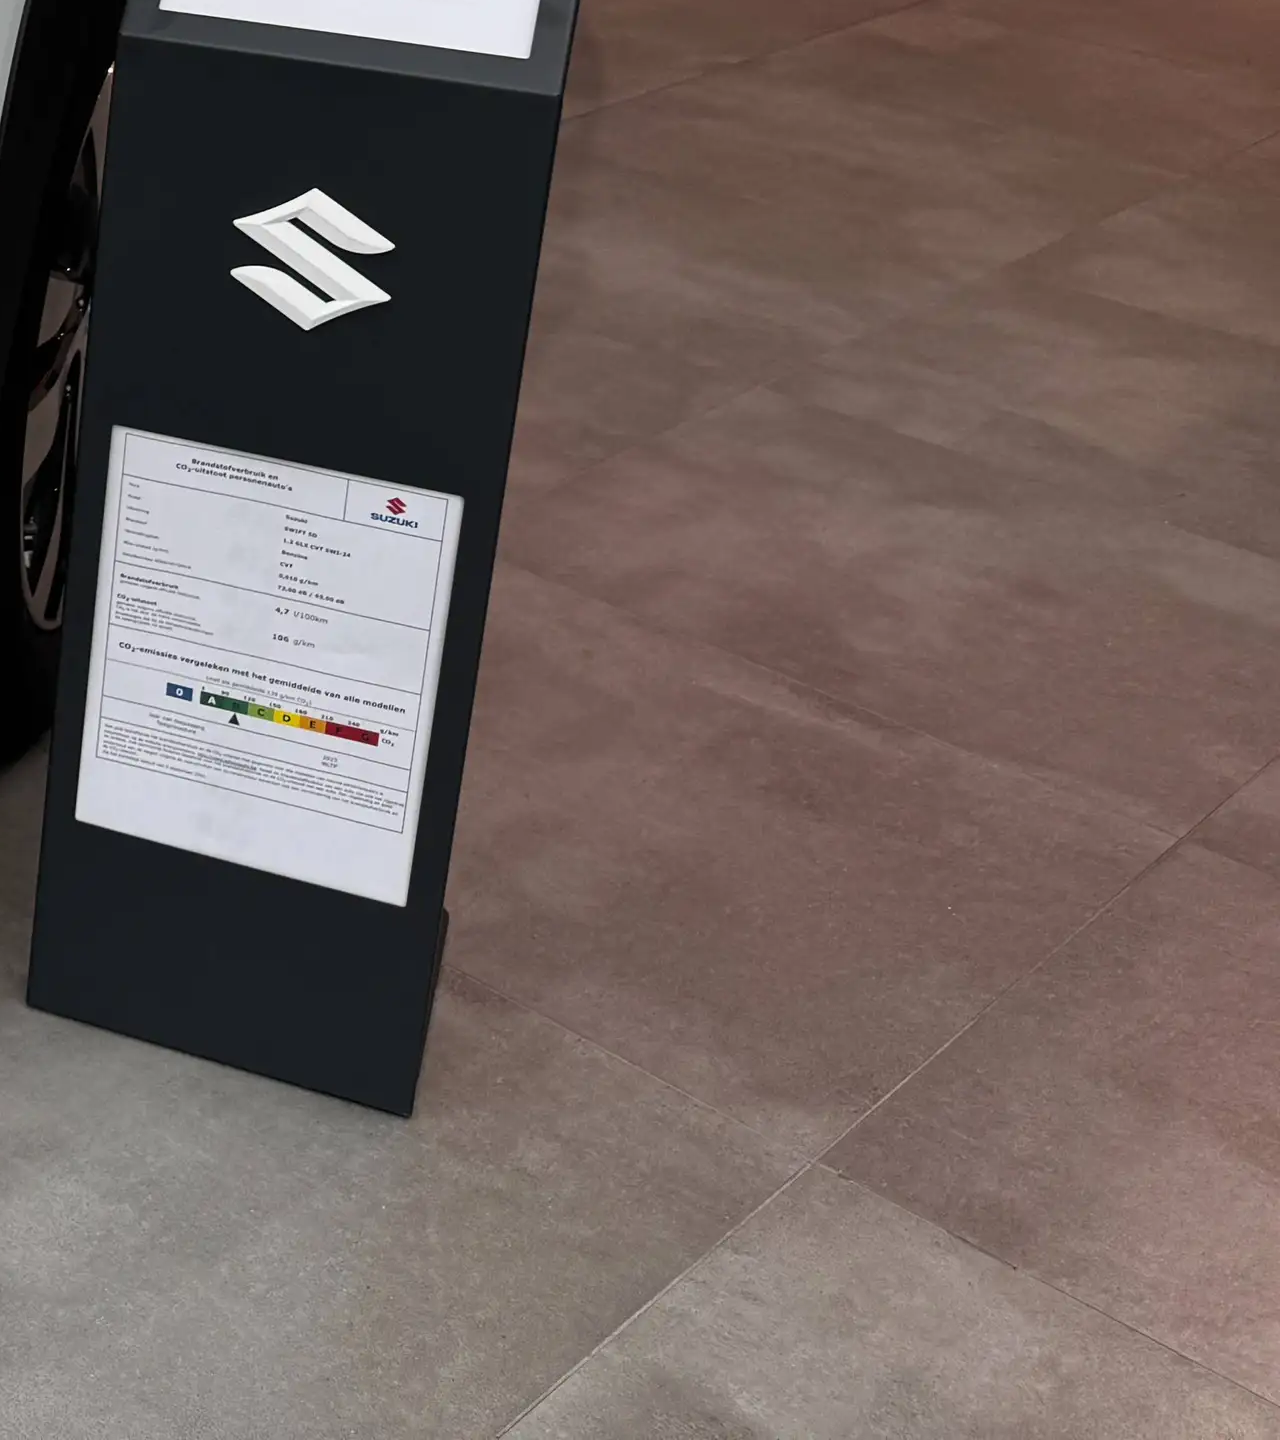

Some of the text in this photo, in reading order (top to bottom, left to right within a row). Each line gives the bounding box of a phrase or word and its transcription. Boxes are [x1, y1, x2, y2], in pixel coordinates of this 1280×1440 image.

[191, 458, 279, 481] Brandstofverbruik en
[285, 513, 308, 524] Suzuki
[370, 512, 419, 529] SUZUKI
[284, 525, 307, 536] SWIFT
[120, 573, 179, 590] Brandstofverbruik
[275, 606, 290, 615] 4,7
[292, 638, 316, 649] g/km
[179, 655, 229, 673] vergeleken
[231, 667, 250, 678] met
[251, 671, 267, 682] het
[268, 675, 322, 696] gemiddelde
[324, 690, 341, 701] van
[343, 693, 361, 704] alle
[362, 699, 406, 714] modellen
[207, 695, 217, 706] A
[257, 708, 265, 717] C
[282, 714, 292, 723] D
[309, 720, 317, 729] E
